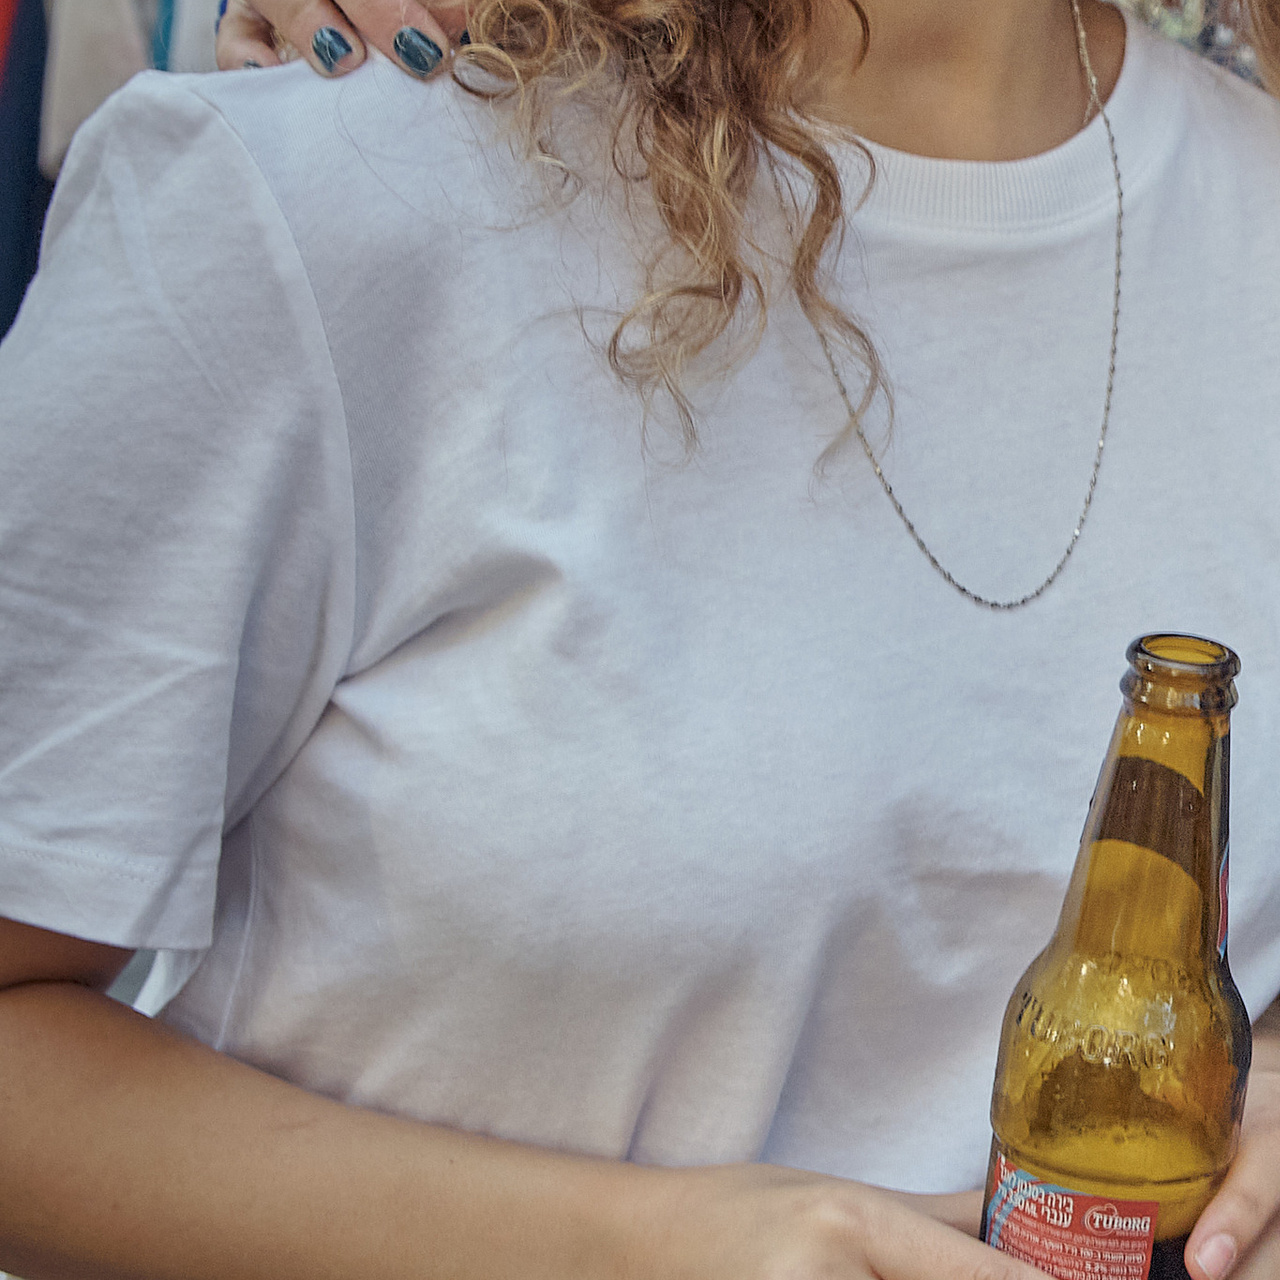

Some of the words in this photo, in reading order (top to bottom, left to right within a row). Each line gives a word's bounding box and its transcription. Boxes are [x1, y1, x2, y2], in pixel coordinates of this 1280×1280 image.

[1048, 1192, 1074, 1214] בירה
[1041, 1204, 1073, 1228] ענברי
[1093, 1211, 1151, 1233] TUBORG
